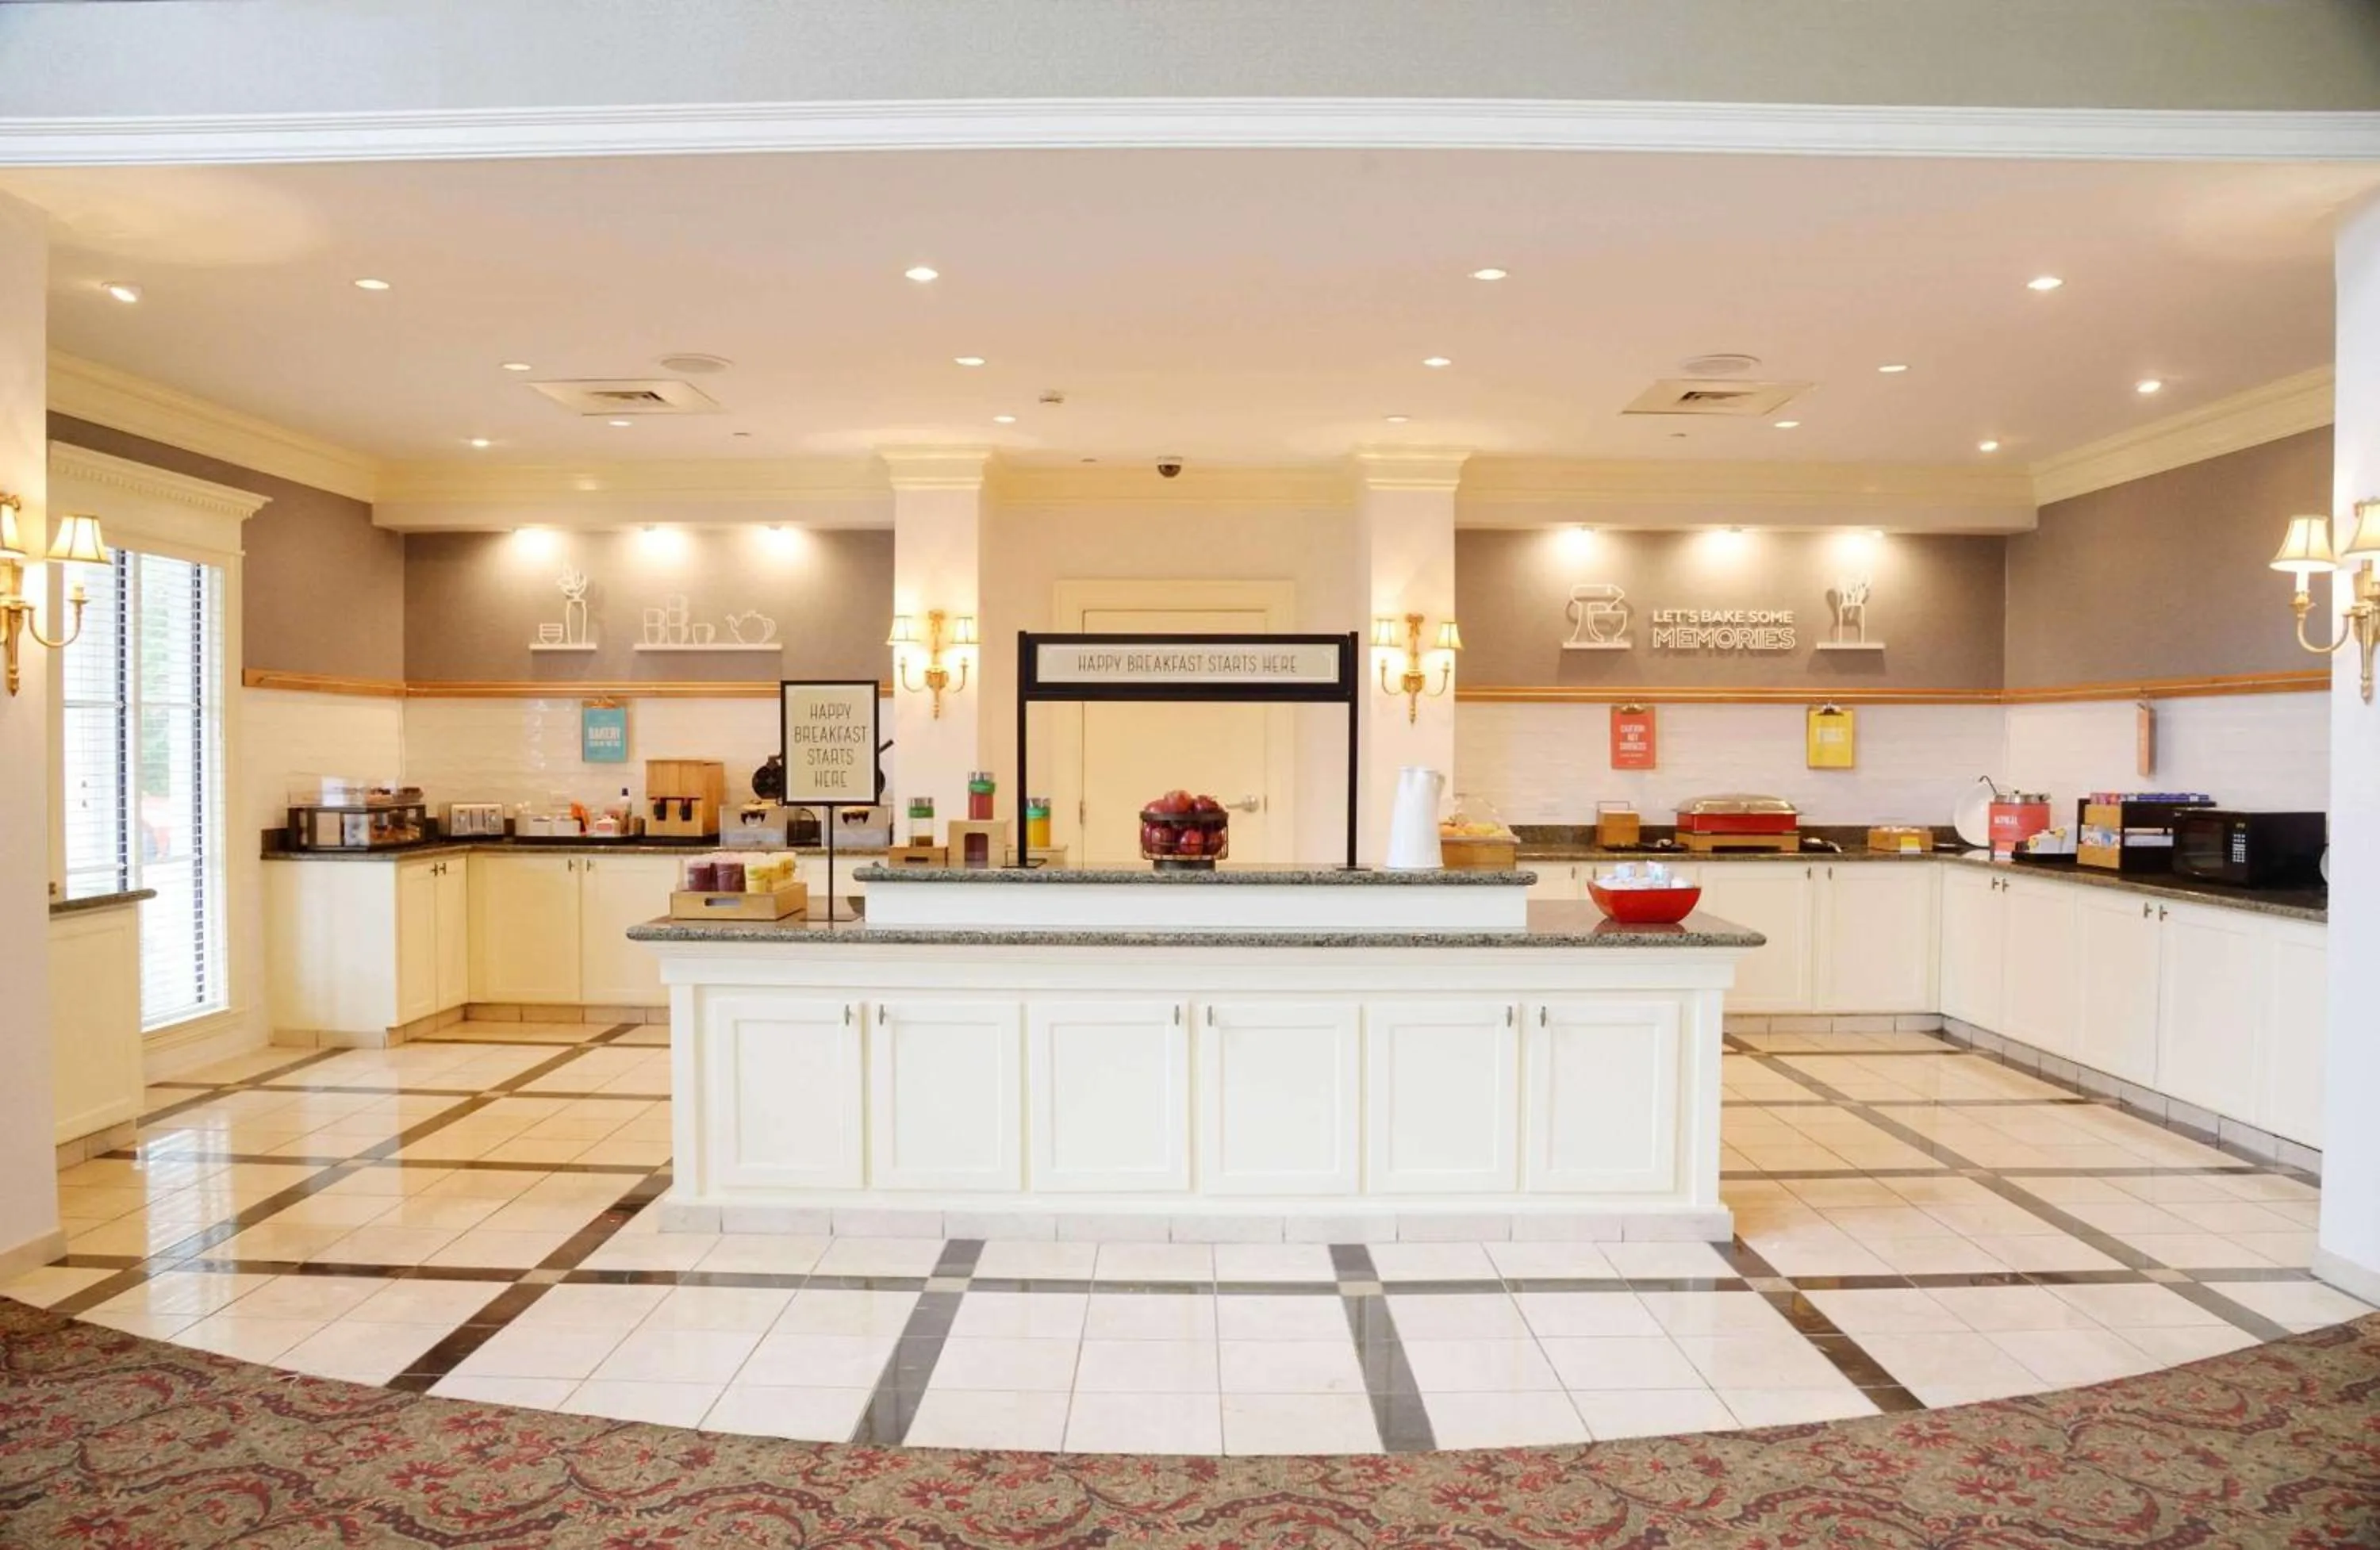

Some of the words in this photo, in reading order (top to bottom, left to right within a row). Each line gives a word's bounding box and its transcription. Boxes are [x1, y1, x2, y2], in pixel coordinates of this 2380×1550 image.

[1653, 609, 1699, 623] LET'S
[1701, 609, 1745, 623] BAKE
[1748, 610, 1795, 623] SOME
[1653, 627, 1796, 650] MEMORIES
[1077, 654, 1122, 673] HAPPY
[1127, 654, 1203, 673] BREAKFAST
[1207, 654, 1257, 674] STARTS
[1261, 654, 1298, 673] HERE
[809, 703, 852, 719] HAPPY
[793, 725, 867, 744] BREAKFAST
[806, 748, 855, 766] STARTS
[814, 770, 848, 788] HERE
